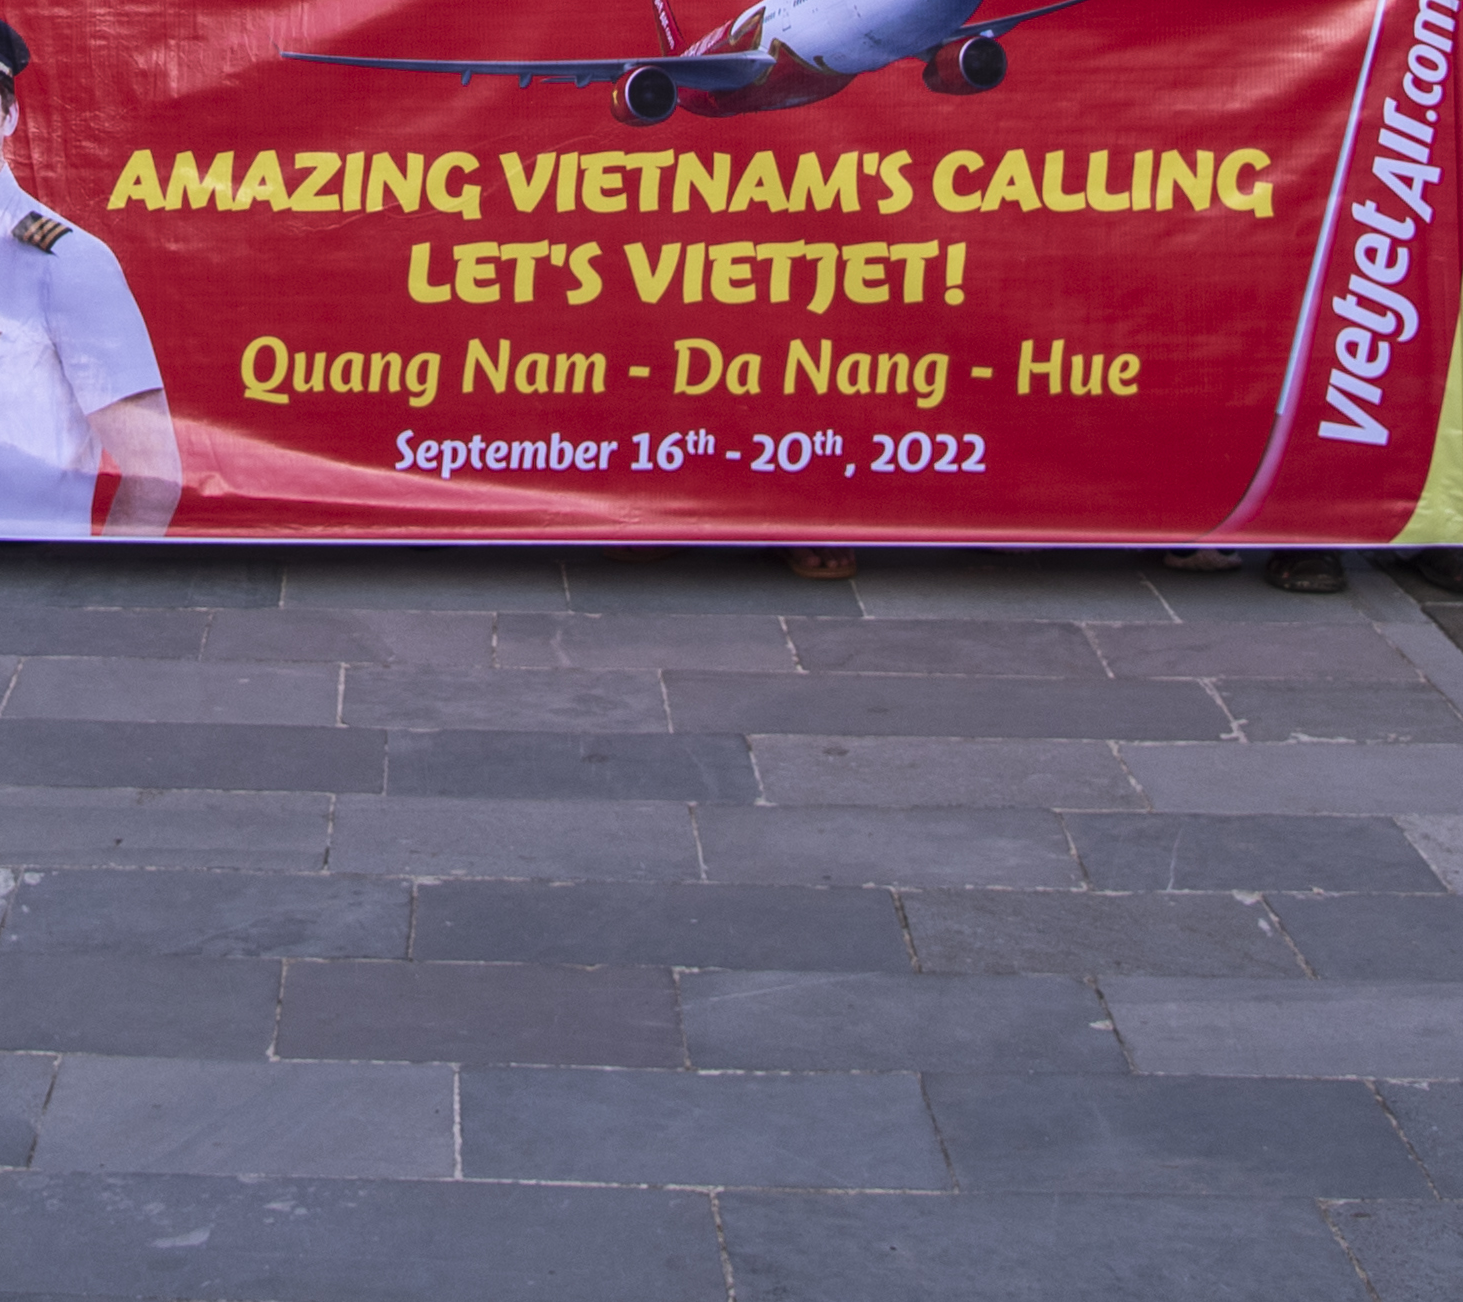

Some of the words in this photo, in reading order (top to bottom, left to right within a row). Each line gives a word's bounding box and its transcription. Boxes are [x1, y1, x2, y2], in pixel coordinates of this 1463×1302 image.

[106, 148, 483, 221] AMAZING
[498, 148, 914, 215] VIETNAM'S
[931, 148, 1274, 219] CALLING
[407, 239, 604, 306] LET'S
[623, 238, 968, 315] VIETJET!
[240, 334, 442, 408] Quang
[461, 337, 608, 395] Nam
[673, 337, 763, 396] Da
[782, 337, 950, 409] Nang
[1016, 338, 1142, 397] Hue
[394, 428, 619, 480] September
[869, 431, 988, 474] 2022
